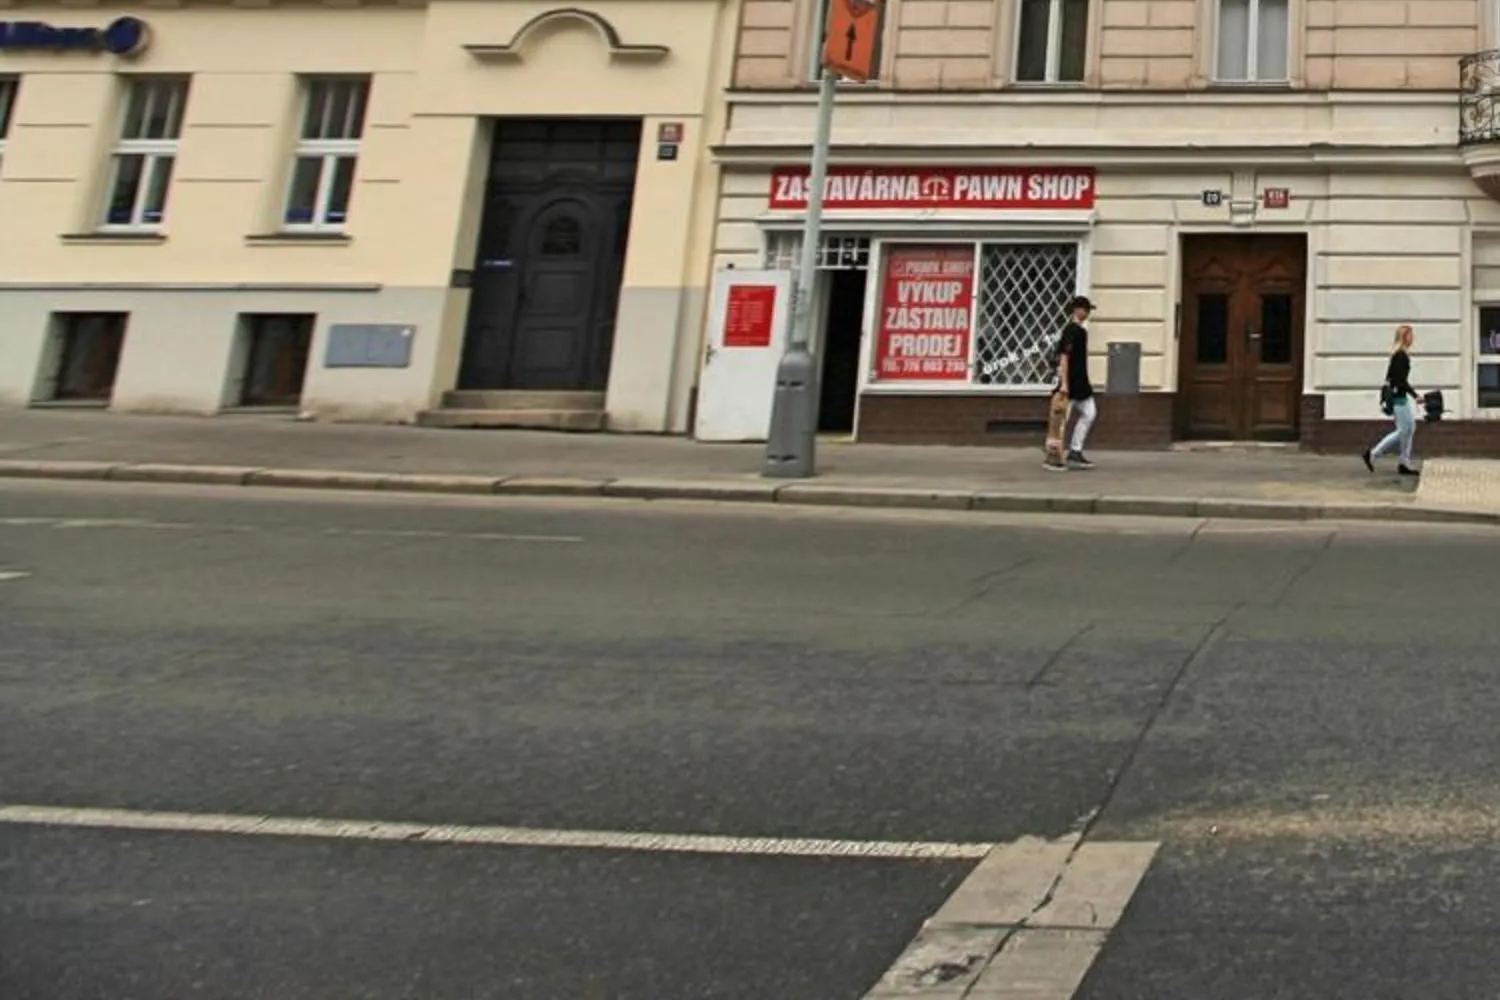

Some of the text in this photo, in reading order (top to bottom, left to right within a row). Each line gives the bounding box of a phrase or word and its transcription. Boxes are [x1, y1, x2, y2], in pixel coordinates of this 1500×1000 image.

[953, 174, 1023, 201] PAWN
[1027, 173, 1090, 201] SHOP
[897, 277, 963, 303] VÝKUP
[885, 304, 968, 331] ZÁSTAVA
[888, 333, 963, 357] PRODEJ
